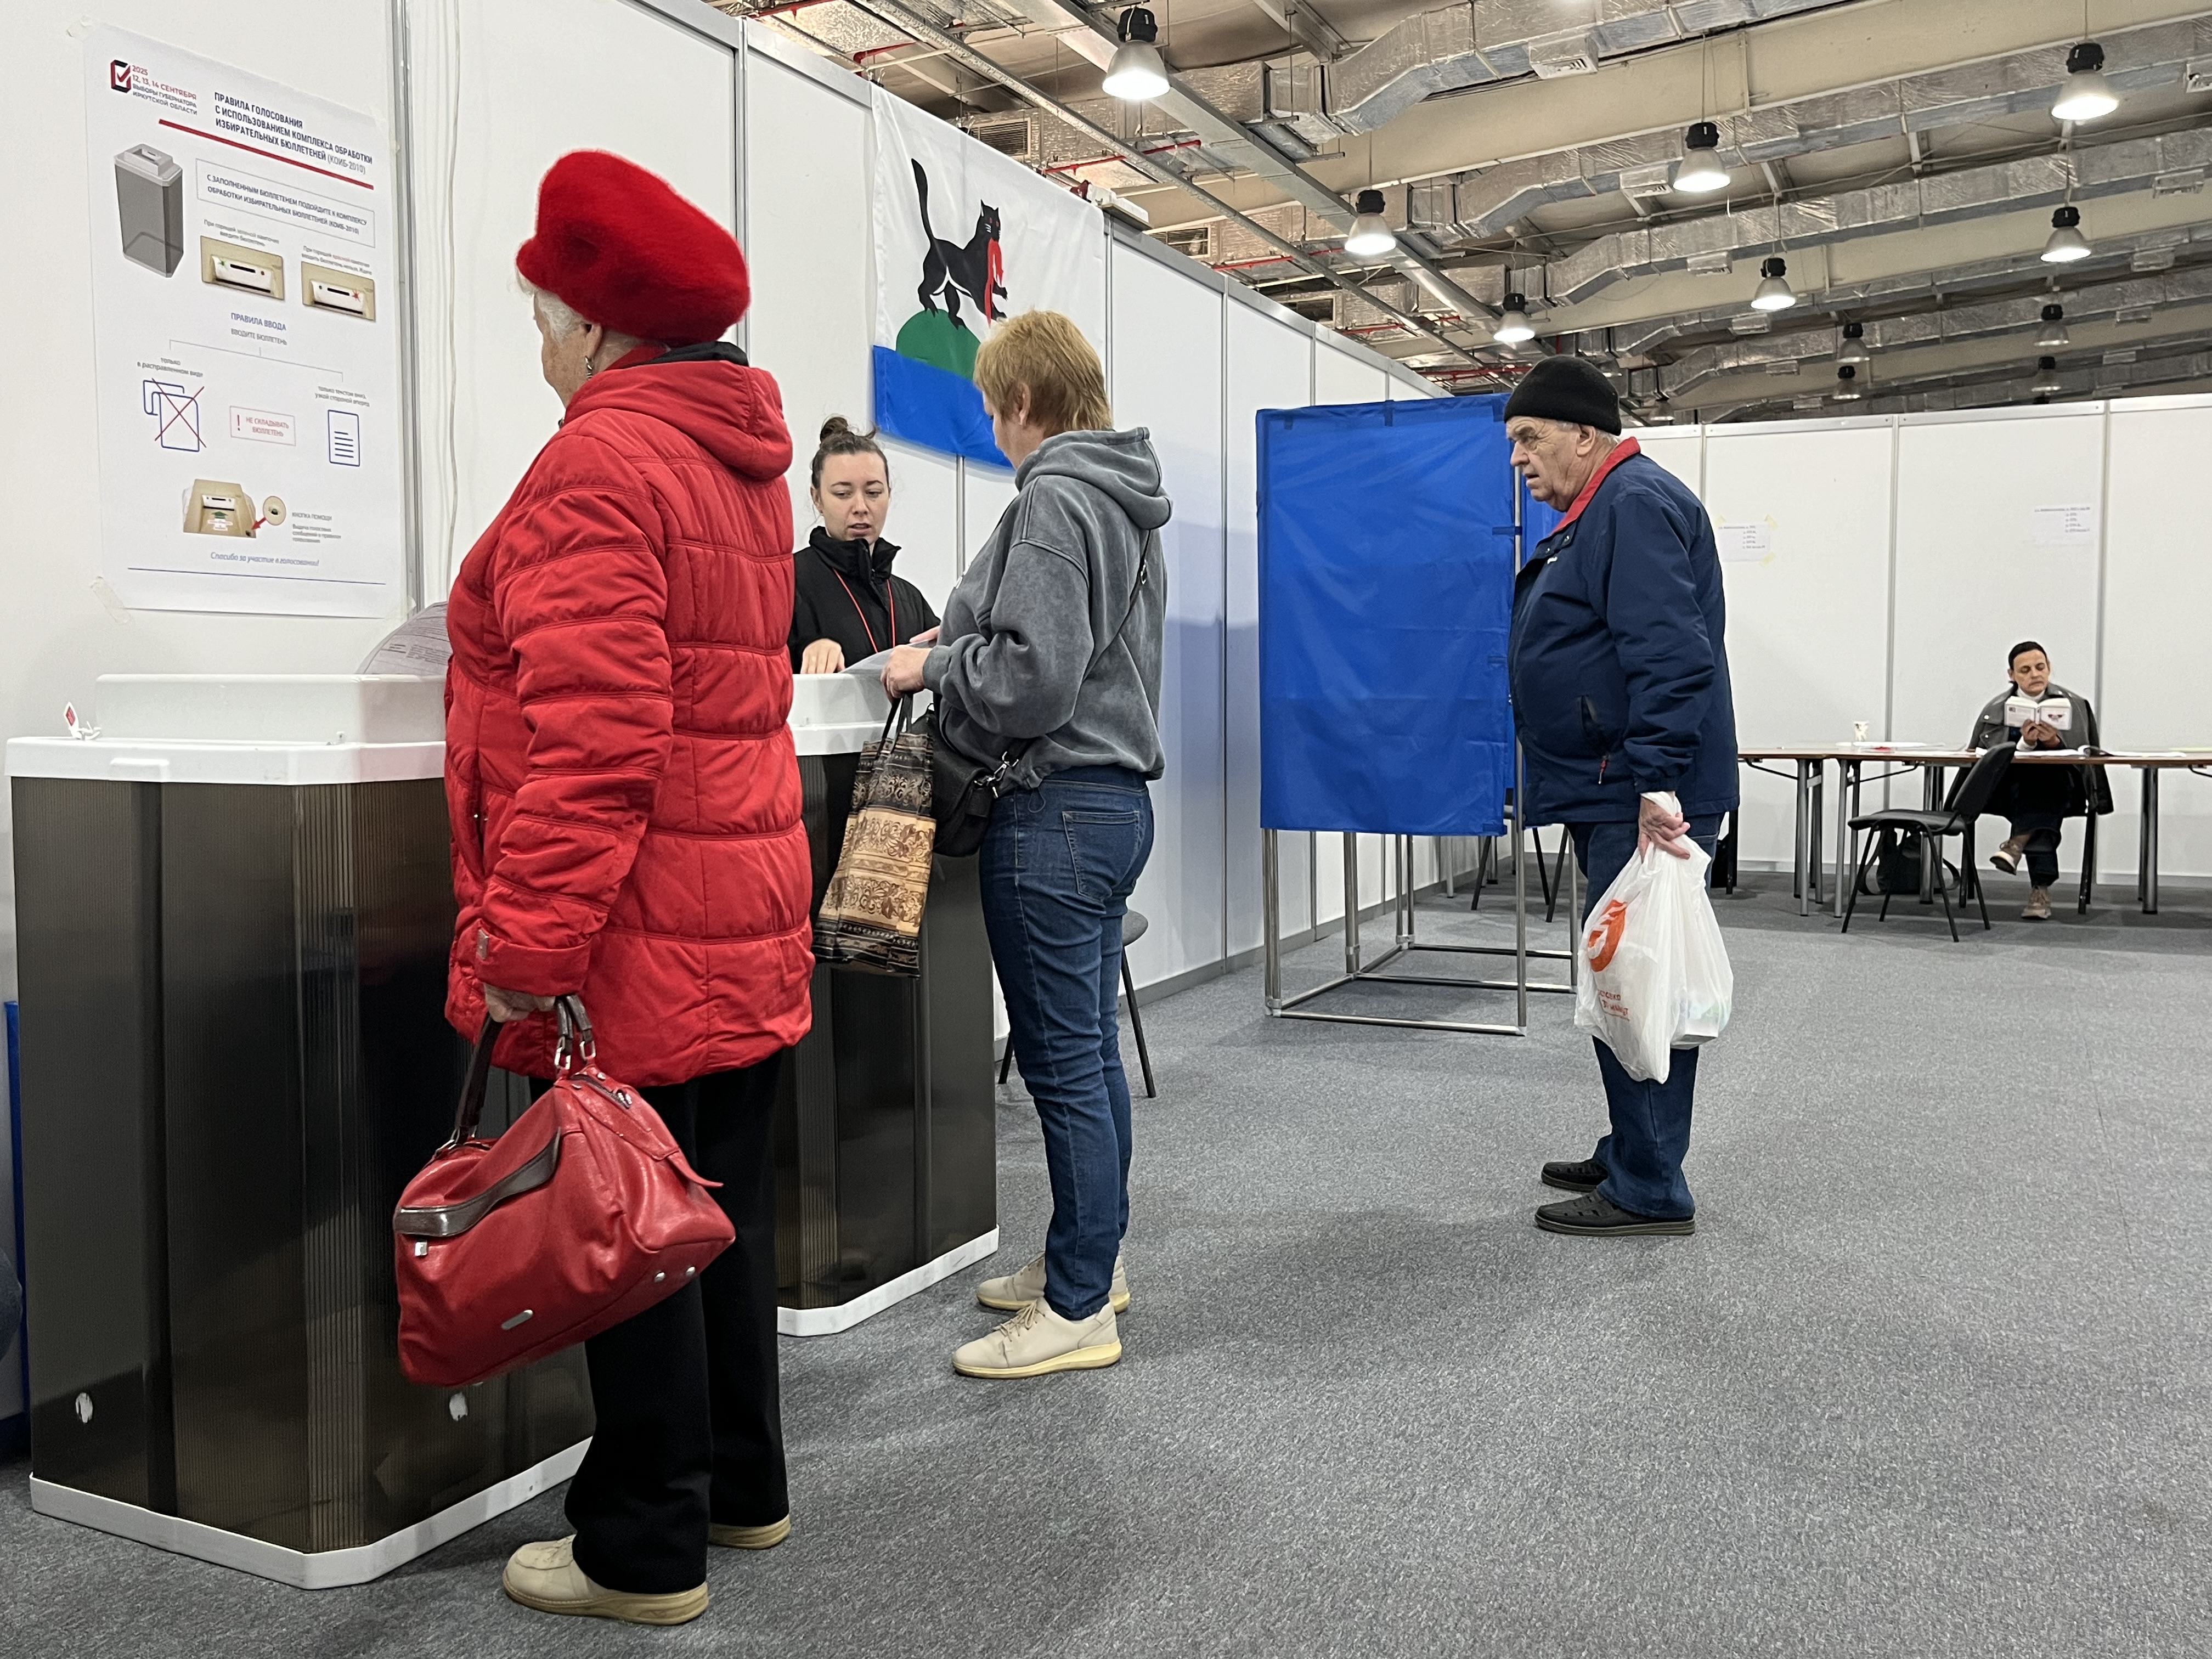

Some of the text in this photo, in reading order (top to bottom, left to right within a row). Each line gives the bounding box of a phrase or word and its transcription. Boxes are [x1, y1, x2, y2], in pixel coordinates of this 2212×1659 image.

[132, 65, 148, 76] 2025
[133, 83, 197, 108] ВЫБОРЫ ГУБЕРНАТОРА
[161, 84, 197, 100] СЕНТЯБРЯ
[133, 91, 197, 115] ИРКУТСКОЙ ОБЛАСТИ
[215, 92, 303, 129] ПРАВИЛА ГОЛОСОВАНИЯ
[215, 105, 373, 165] С ИСПОЛЬЗОВАНИЕМ КОМПЛЕКСА ОБРАБОТКИ
[216, 118, 366, 174] ИЗБИРАТЕЛЬНЫХ БЮЛЛЕТЕНЕЙ (КОИБ-2010)
[207, 186, 359, 235] ОБРАБОТКИ ИЗБИРАТЕЛЬНЫХ БЮЛЛЕТЕНЕЙ (КОИБ-2010)
[212, 175, 259, 194] ЗАПОЛНЕННЫМ
[259, 189, 297, 205] БЮЛЛЕТЕНЕМ
[298, 200, 331, 216] ПОДОЙДИТЕ
[336, 212, 367, 226] КОМПЛЕКСУ
[231, 312, 286, 331] ПРАВИЛА ВВОДА
[231, 328, 256, 340] ВВОДИТЕ
[252, 426, 284, 437] БЮЛЛЕТЕНЬ
[254, 418, 289, 429] СКЛАДЫВАТЬ
[210, 551, 239, 561] Спасибо
